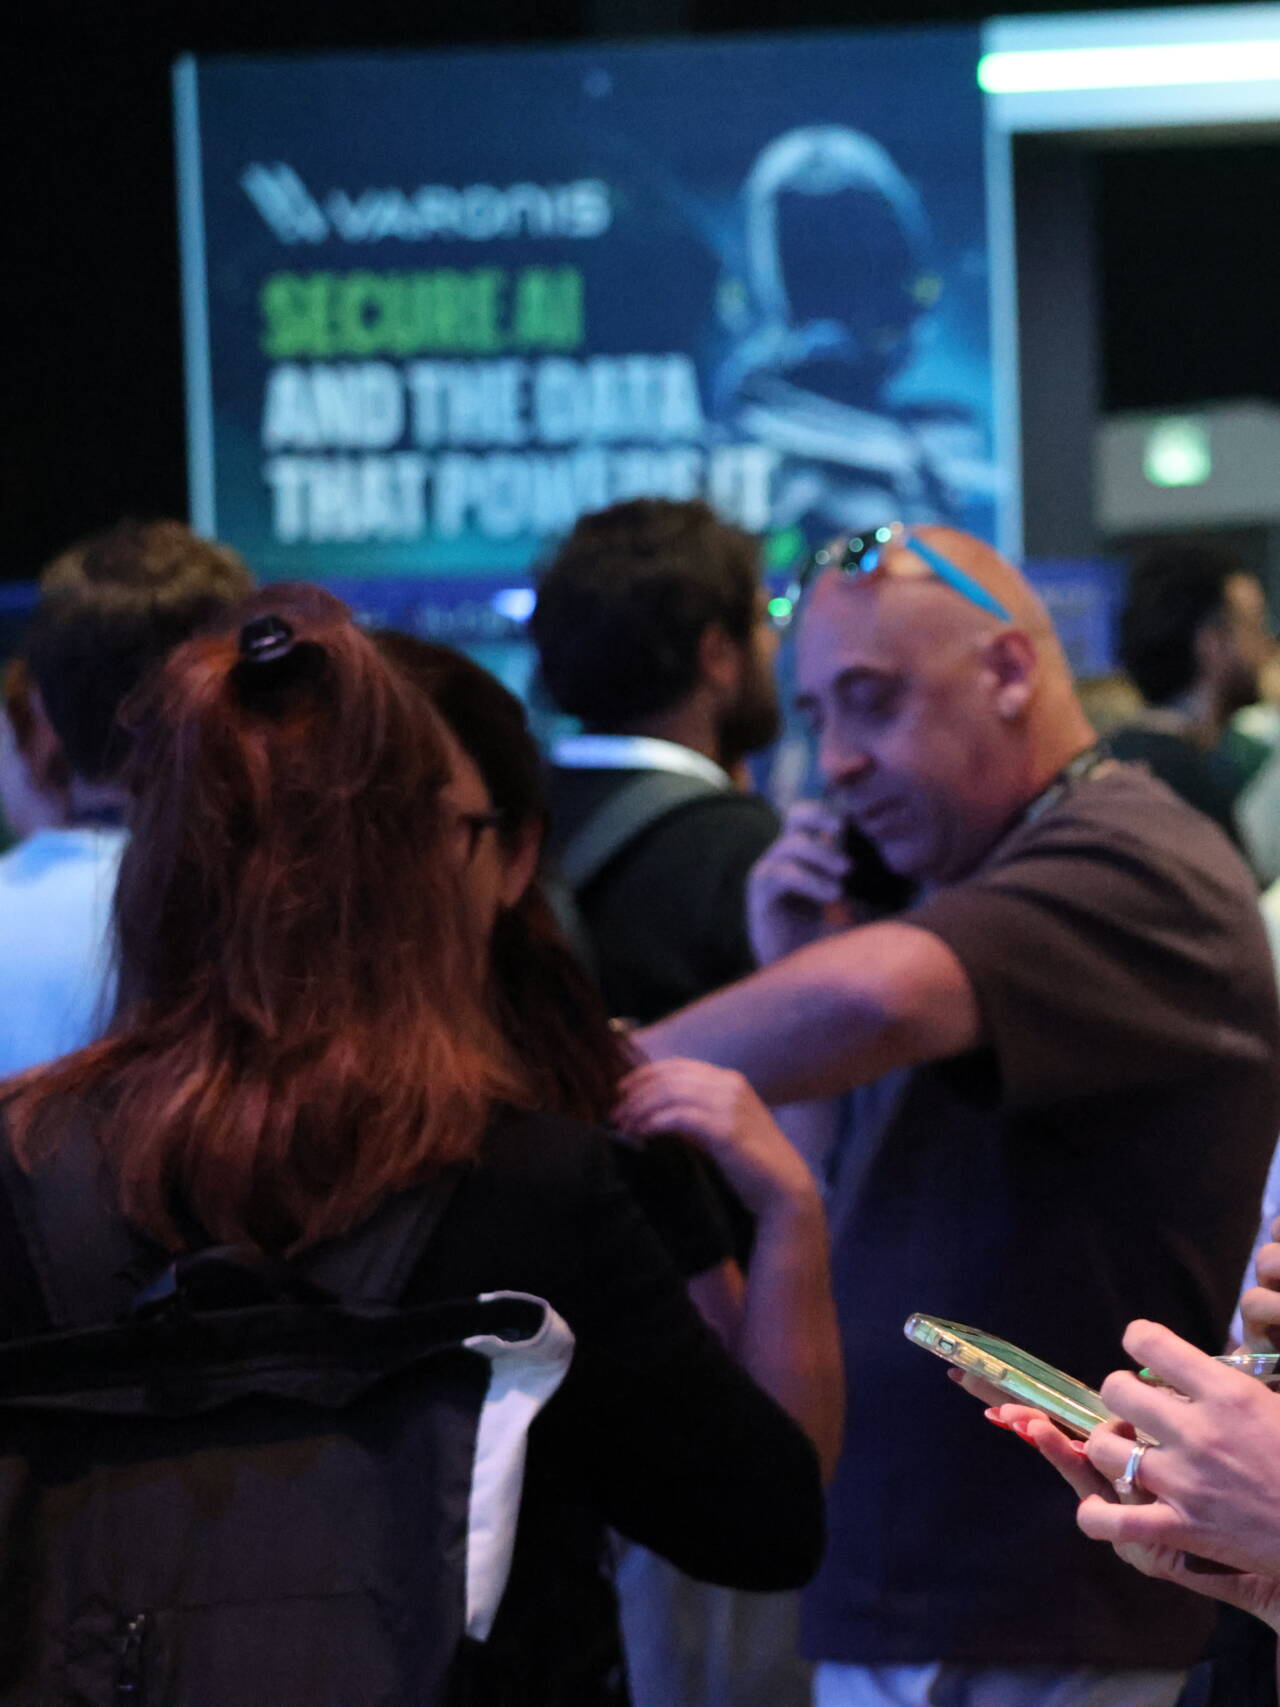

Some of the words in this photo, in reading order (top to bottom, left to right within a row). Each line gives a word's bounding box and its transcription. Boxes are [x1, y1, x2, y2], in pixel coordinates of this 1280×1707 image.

[264, 361, 404, 450] AND
[407, 356, 522, 447] THE
[532, 353, 702, 446] DATA
[266, 450, 427, 544] THAT
